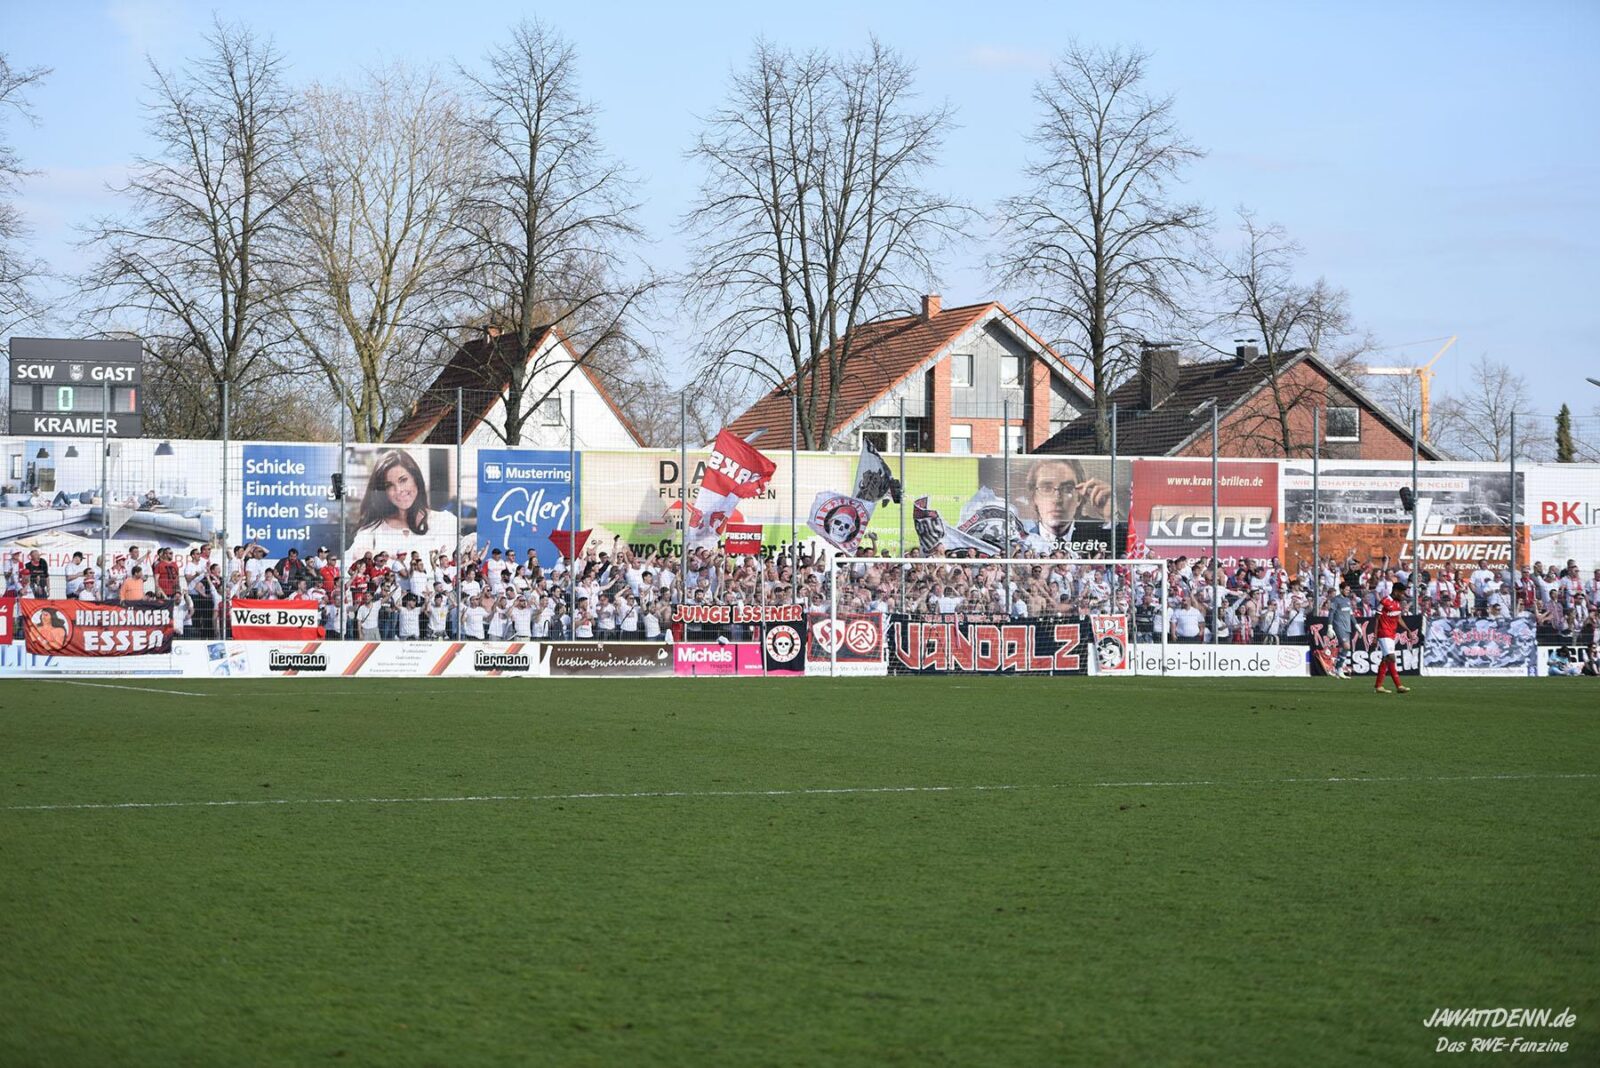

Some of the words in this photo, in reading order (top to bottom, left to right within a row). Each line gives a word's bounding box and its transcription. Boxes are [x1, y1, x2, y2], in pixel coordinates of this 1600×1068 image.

[17, 364, 55, 379] SCW
[91, 366, 136, 381] GAST
[58, 386, 74, 411] 0
[34, 418, 118, 434] KRAMER
[246, 459, 305, 475] Schicke
[505, 467, 571, 481] Musterring
[1167, 475, 1264, 487] www.kran-brillen.de
[246, 482, 357, 501] Einrichtungn
[246, 503, 299, 520] finden
[305, 504, 328, 519] Sie
[491, 486, 571, 550] Gallery
[246, 525, 271, 540] bei
[277, 525, 310, 540] uns!
[1152, 511, 1267, 537] krane
[1400, 543, 1512, 560] LANDWEHR
[75, 607, 171, 627] HAFENSÄNGER
[233, 610, 271, 624] West
[277, 610, 315, 628] Boys
[671, 604, 731, 624] JUNGE
[1095, 620, 1123, 634] LPL
[83, 630, 164, 651] ESSEN
[678, 648, 733, 662] Michels
